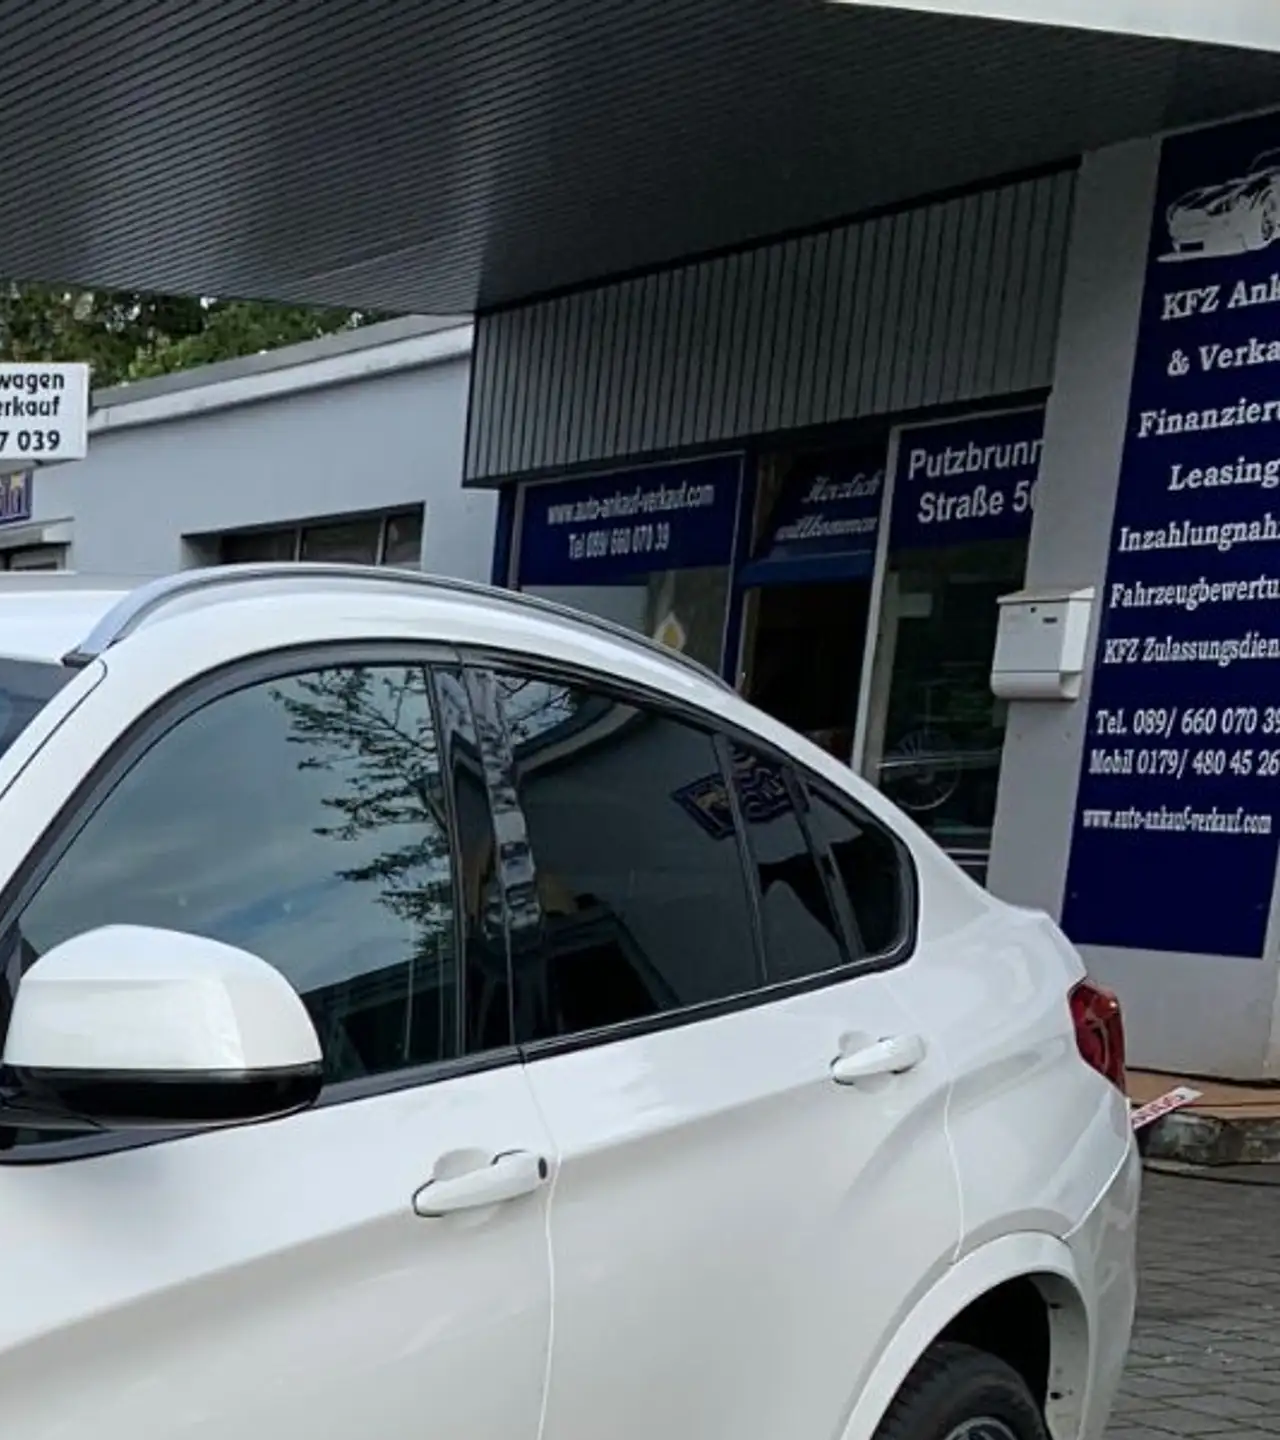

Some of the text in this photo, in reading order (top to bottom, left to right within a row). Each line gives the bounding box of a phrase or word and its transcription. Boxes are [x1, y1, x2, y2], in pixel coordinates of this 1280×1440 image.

[1160, 284, 1221, 321] KFZ
[1167, 348, 1190, 377] &
[1137, 397, 1280, 439] Finanzier
[17, 430, 61, 452] 039
[1168, 455, 1280, 492] Leasing
[916, 483, 1005, 524] Straße
[1117, 511, 1280, 552] Inzahlungnah
[1109, 573, 1280, 611] Fahrzeugbewertu
[1103, 637, 1140, 664] KFZ
[1096, 709, 1128, 736] Tel.
[1133, 707, 1178, 739] 089/
[1181, 707, 1217, 735] 660
[1221, 706, 1258, 735] 070
[1088, 748, 1280, 780] Mobil 0179/ 480 45 26
[1083, 805, 1272, 835] www.auto-ankauf-verkauf.com
